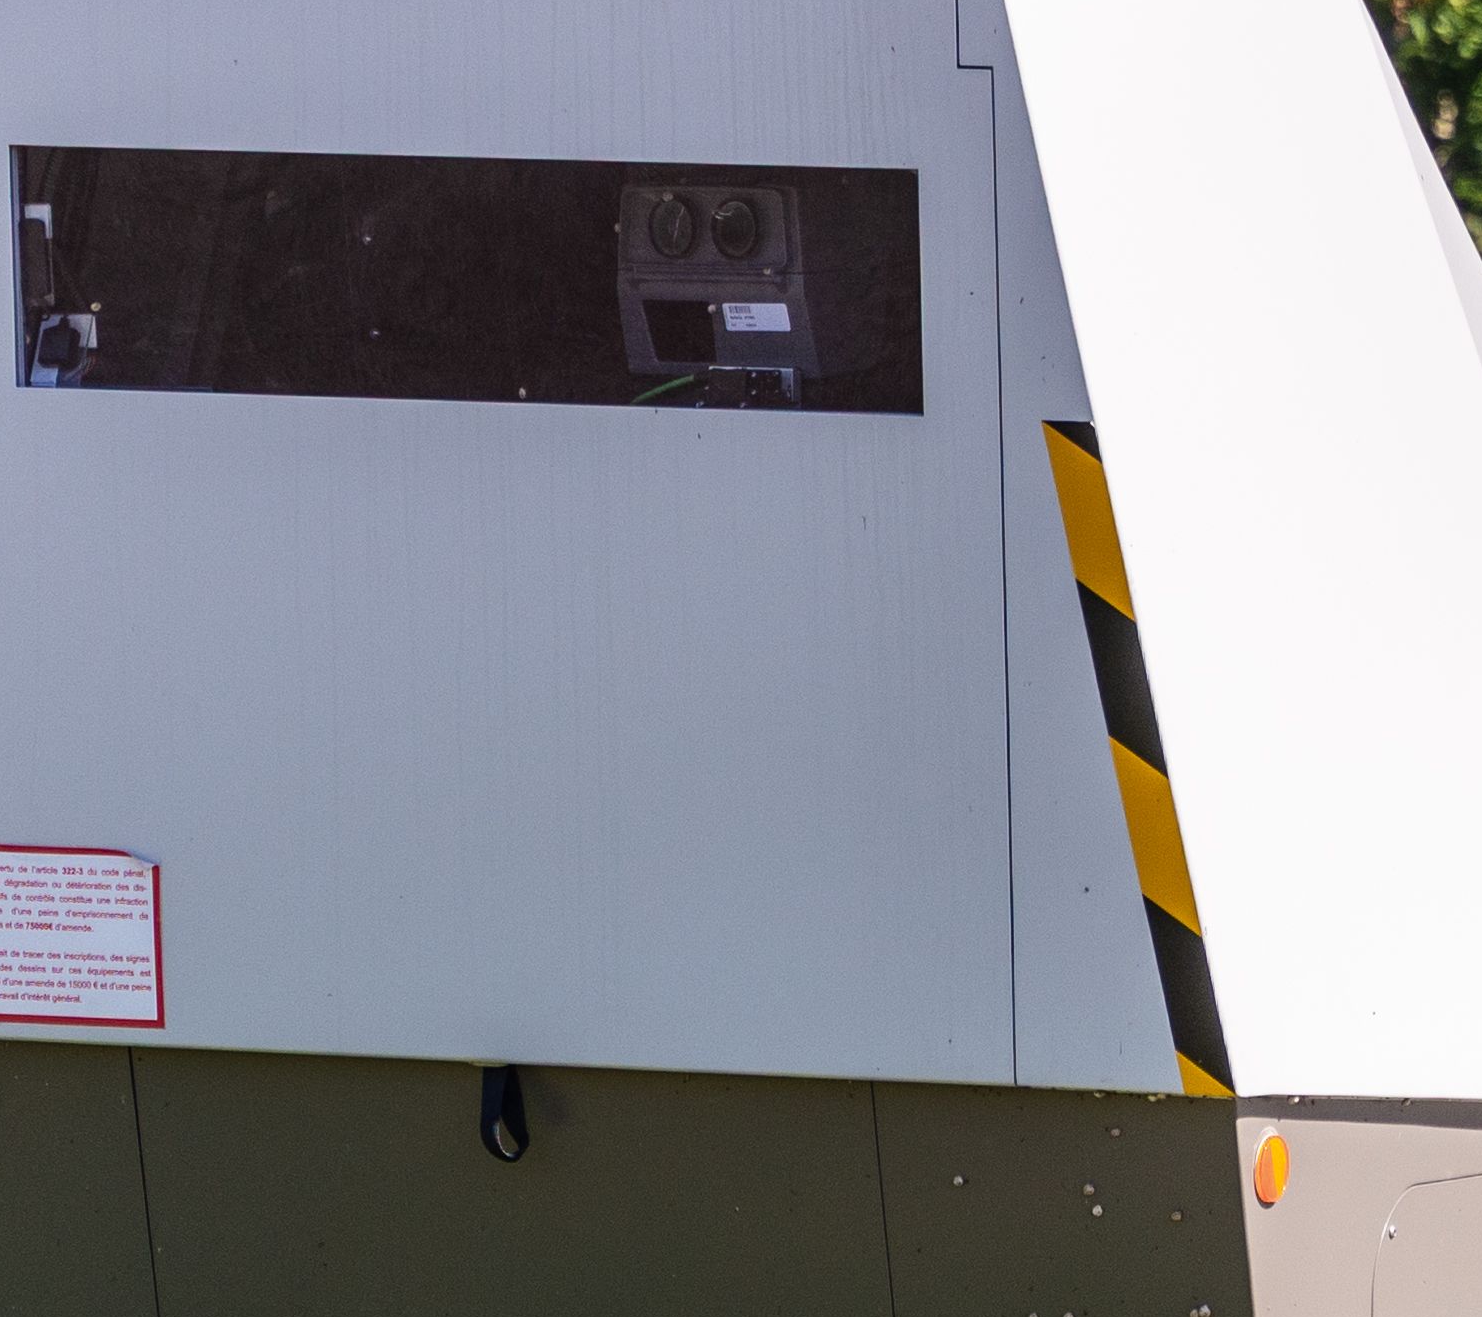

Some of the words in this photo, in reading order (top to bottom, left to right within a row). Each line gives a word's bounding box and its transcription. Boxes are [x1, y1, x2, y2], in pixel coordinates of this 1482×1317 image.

[18, 865, 28, 873] de
[31, 866, 57, 875] l'article
[62, 867, 83, 875] 322-3
[88, 868, 97, 876] du
[102, 868, 119, 876] code
[124, 869, 146, 879] pénal,
[4, 879, 47, 889] dégradation
[66, 881, 111, 890] détérioration
[115, 883, 129, 891] des
[12, 893, 21, 901] de
[26, 893, 54, 903] contrôle
[59, 895, 92, 904] constitue
[115, 897, 148, 905] infraction
[12, 907, 31, 916] d'une
[65, 909, 133, 920] d'emprisonnement
[139, 912, 148, 920] de
[55, 923, 94, 932] d'amende.
[23, 951, 44, 959] tracer
[64, 952, 107, 962] inscriptions,
[126, 955, 149, 964] signes
[18, 964, 46, 973] dessins
[87, 967, 134, 977] équipements
[2, 978, 22, 986] d'une
[69, 981, 91, 989] 15000
[131, 984, 151, 992] peine
[21, 993, 50, 1001] d'intérêt
[52, 994, 82, 1004] général.
